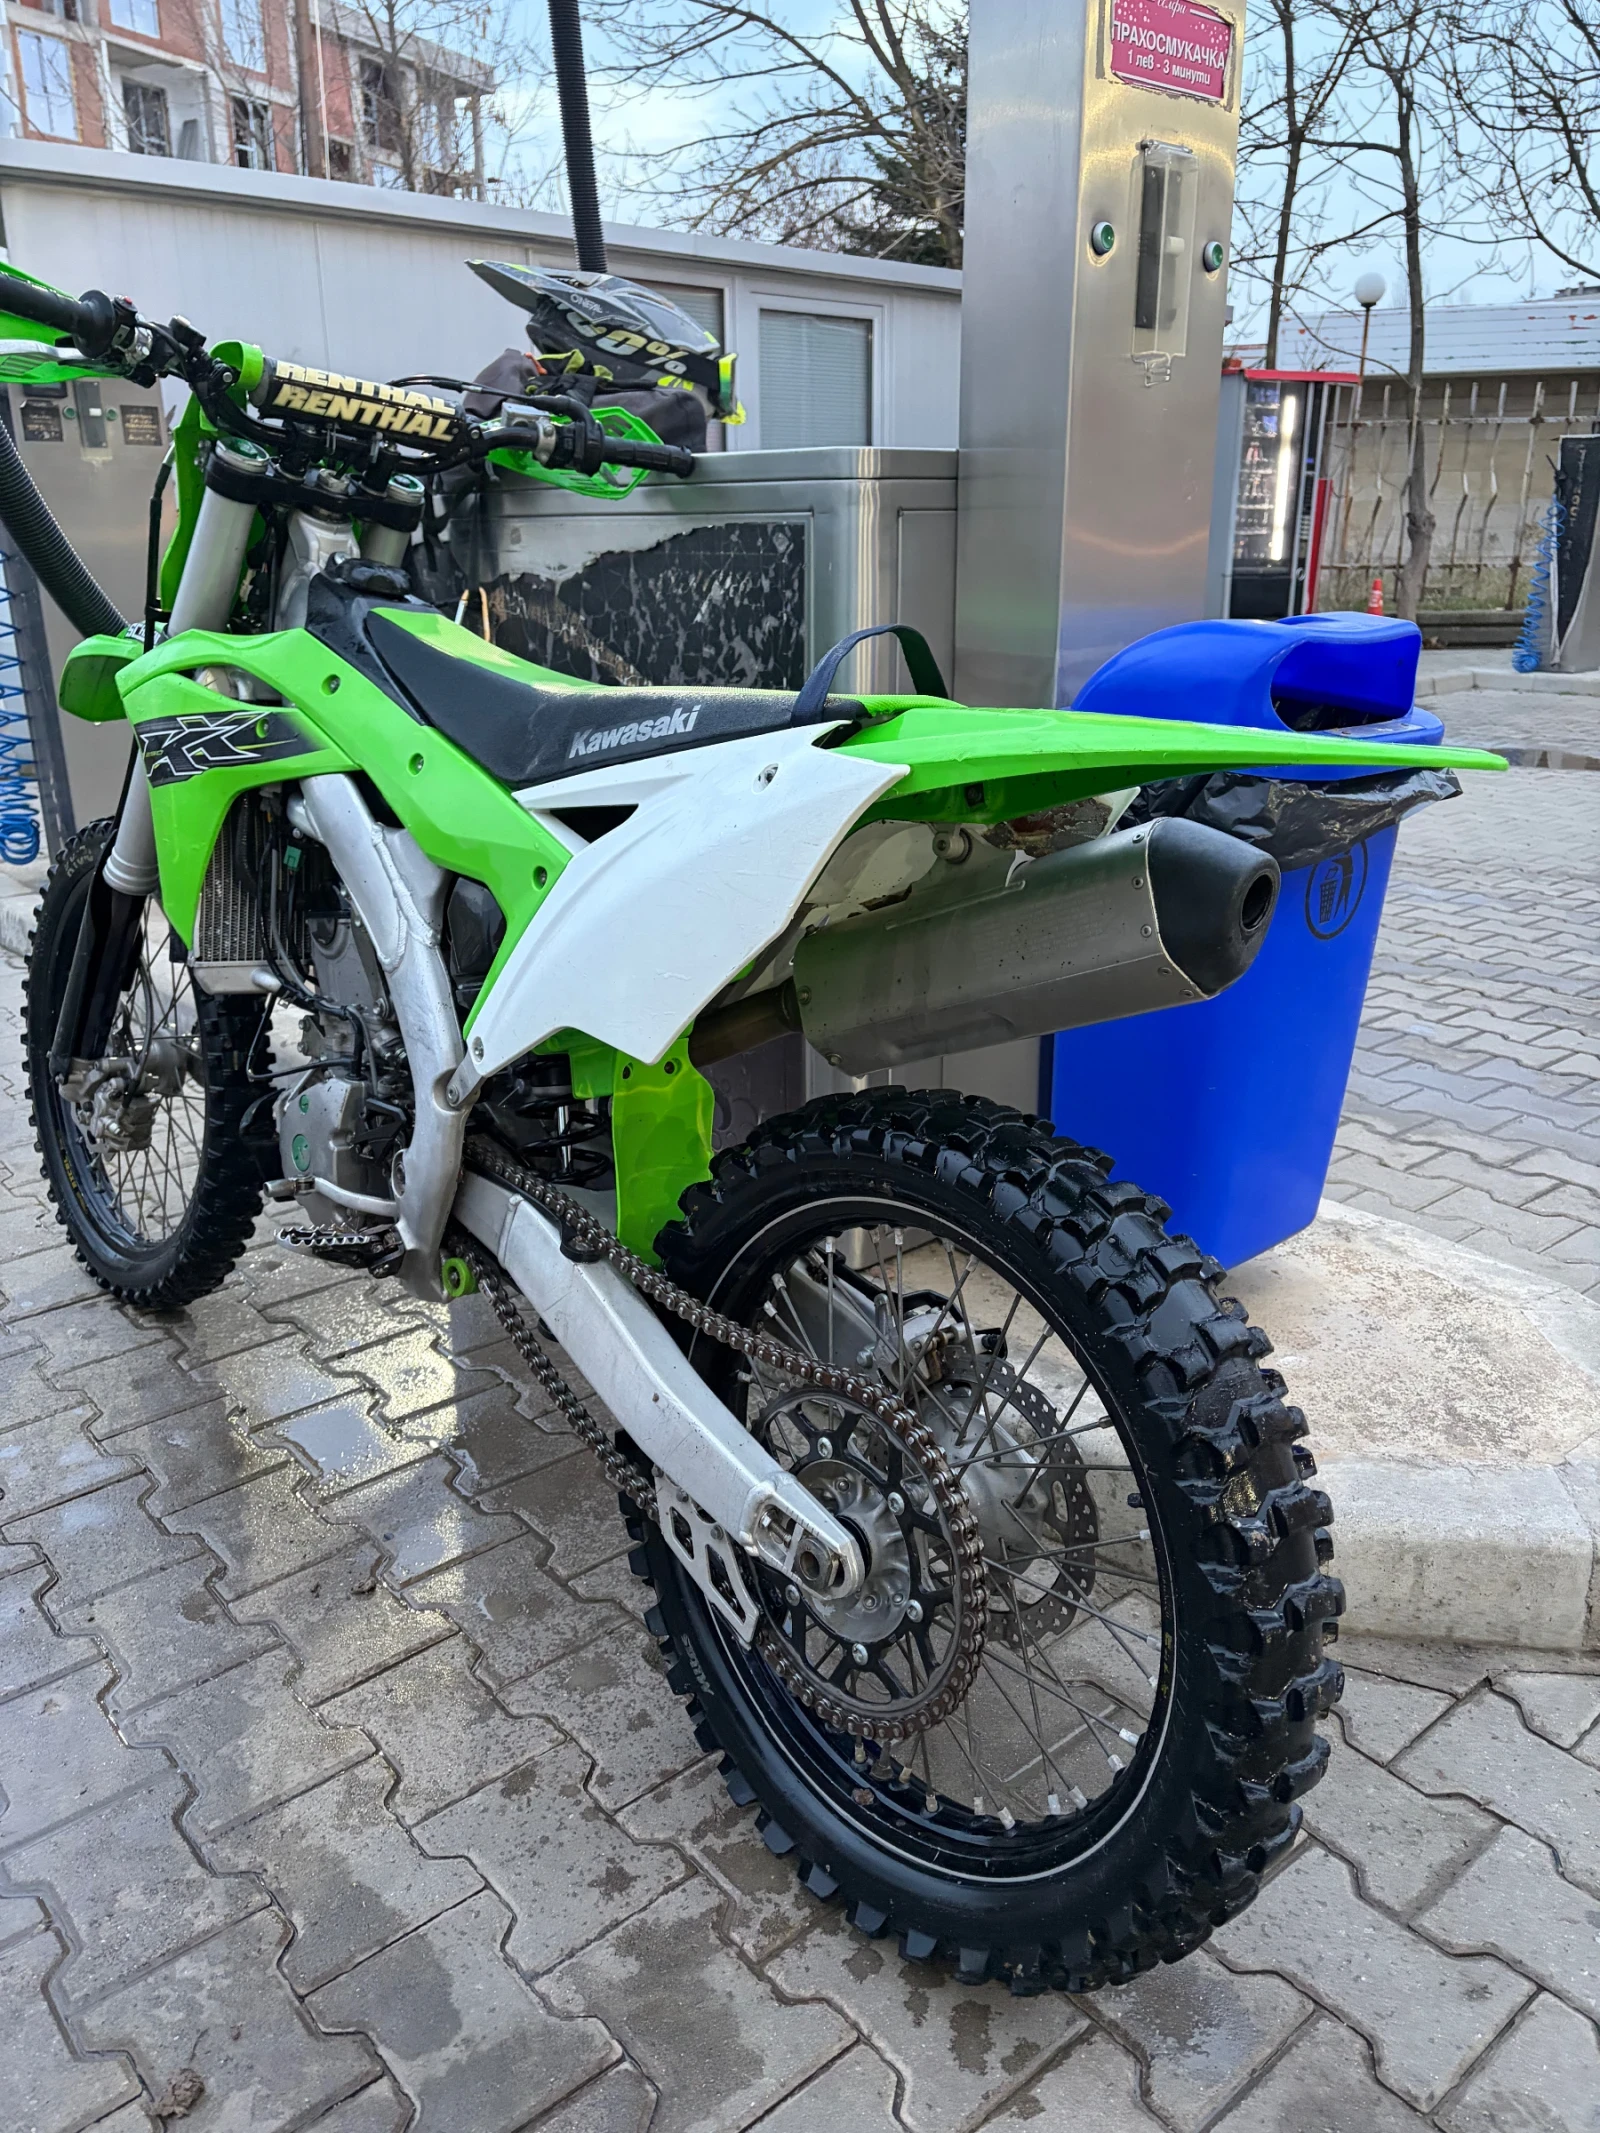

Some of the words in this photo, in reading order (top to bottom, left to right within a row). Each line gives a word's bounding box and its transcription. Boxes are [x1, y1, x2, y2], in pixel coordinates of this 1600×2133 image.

[1112, 20, 1225, 70] ПРАХОСМУКАЧКА
[1128, 49, 1134, 64] 1
[1136, 54, 1155, 70] лев
[1163, 59, 1170, 74] 3
[1172, 64, 1211, 86] минути
[273, 383, 454, 442] RENTHAL
[276, 360, 456, 415] RENTHAL
[568, 704, 702, 759] Kawasaki
